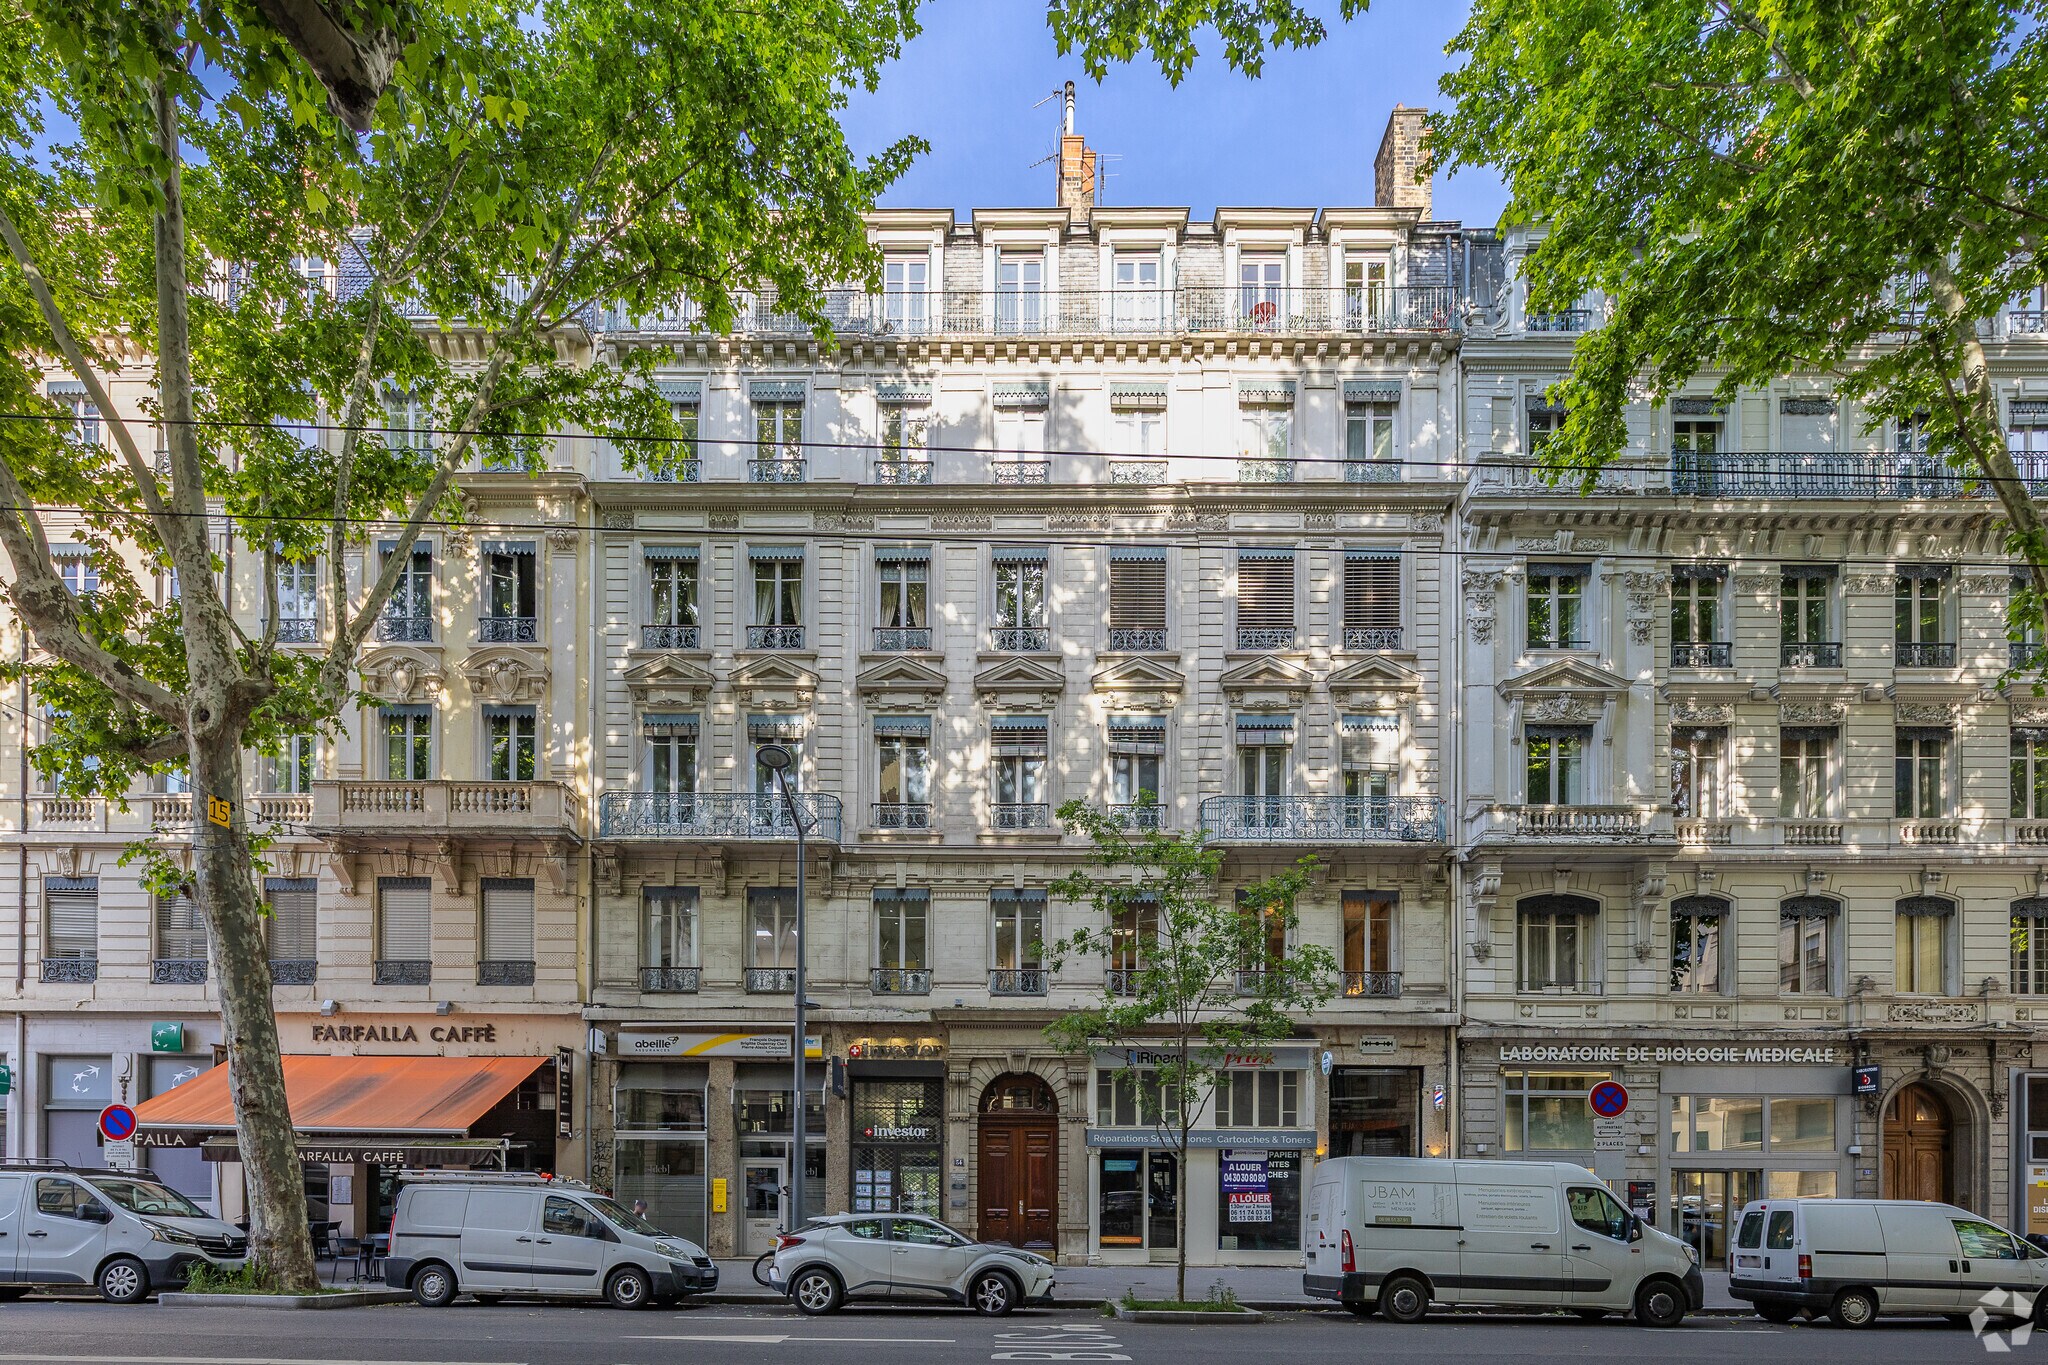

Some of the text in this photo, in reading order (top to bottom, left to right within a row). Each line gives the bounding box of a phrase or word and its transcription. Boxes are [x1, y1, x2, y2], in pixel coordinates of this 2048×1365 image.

[209, 801, 229, 823] 15
[312, 1023, 497, 1043] FARFALLA CAFFÈ
[634, 1039, 671, 1049] abeille
[861, 1040, 943, 1057] investor
[1500, 1046, 1834, 1062] LABORATOIRE DE BIOLOGIE MEDICALE
[873, 1124, 929, 1137] investor
[129, 1133, 187, 1146] FALLA
[1093, 1134, 1149, 1143] Réparations
[1217, 1135, 1270, 1144] Cartouches
[1271, 1135, 1279, 1144] &
[1280, 1135, 1312, 1144] Toners
[362, 1150, 404, 1162] CAFFÈ
[1268, 1151, 1299, 1159] PAPIER
[1228, 1163, 1262, 1172] A LOUER
[1268, 1160, 1290, 1168] NTES
[1223, 1173, 1233, 1182] 04
[1233, 1173, 1241, 1182] 30
[1240, 1173, 1249, 1182] 30
[1267, 1171, 1289, 1179] CHES
[1367, 1185, 1416, 1199] JBAM
[1230, 1194, 1271, 1203] A LOUER
[2033, 1205, 2048, 1213] DIS
